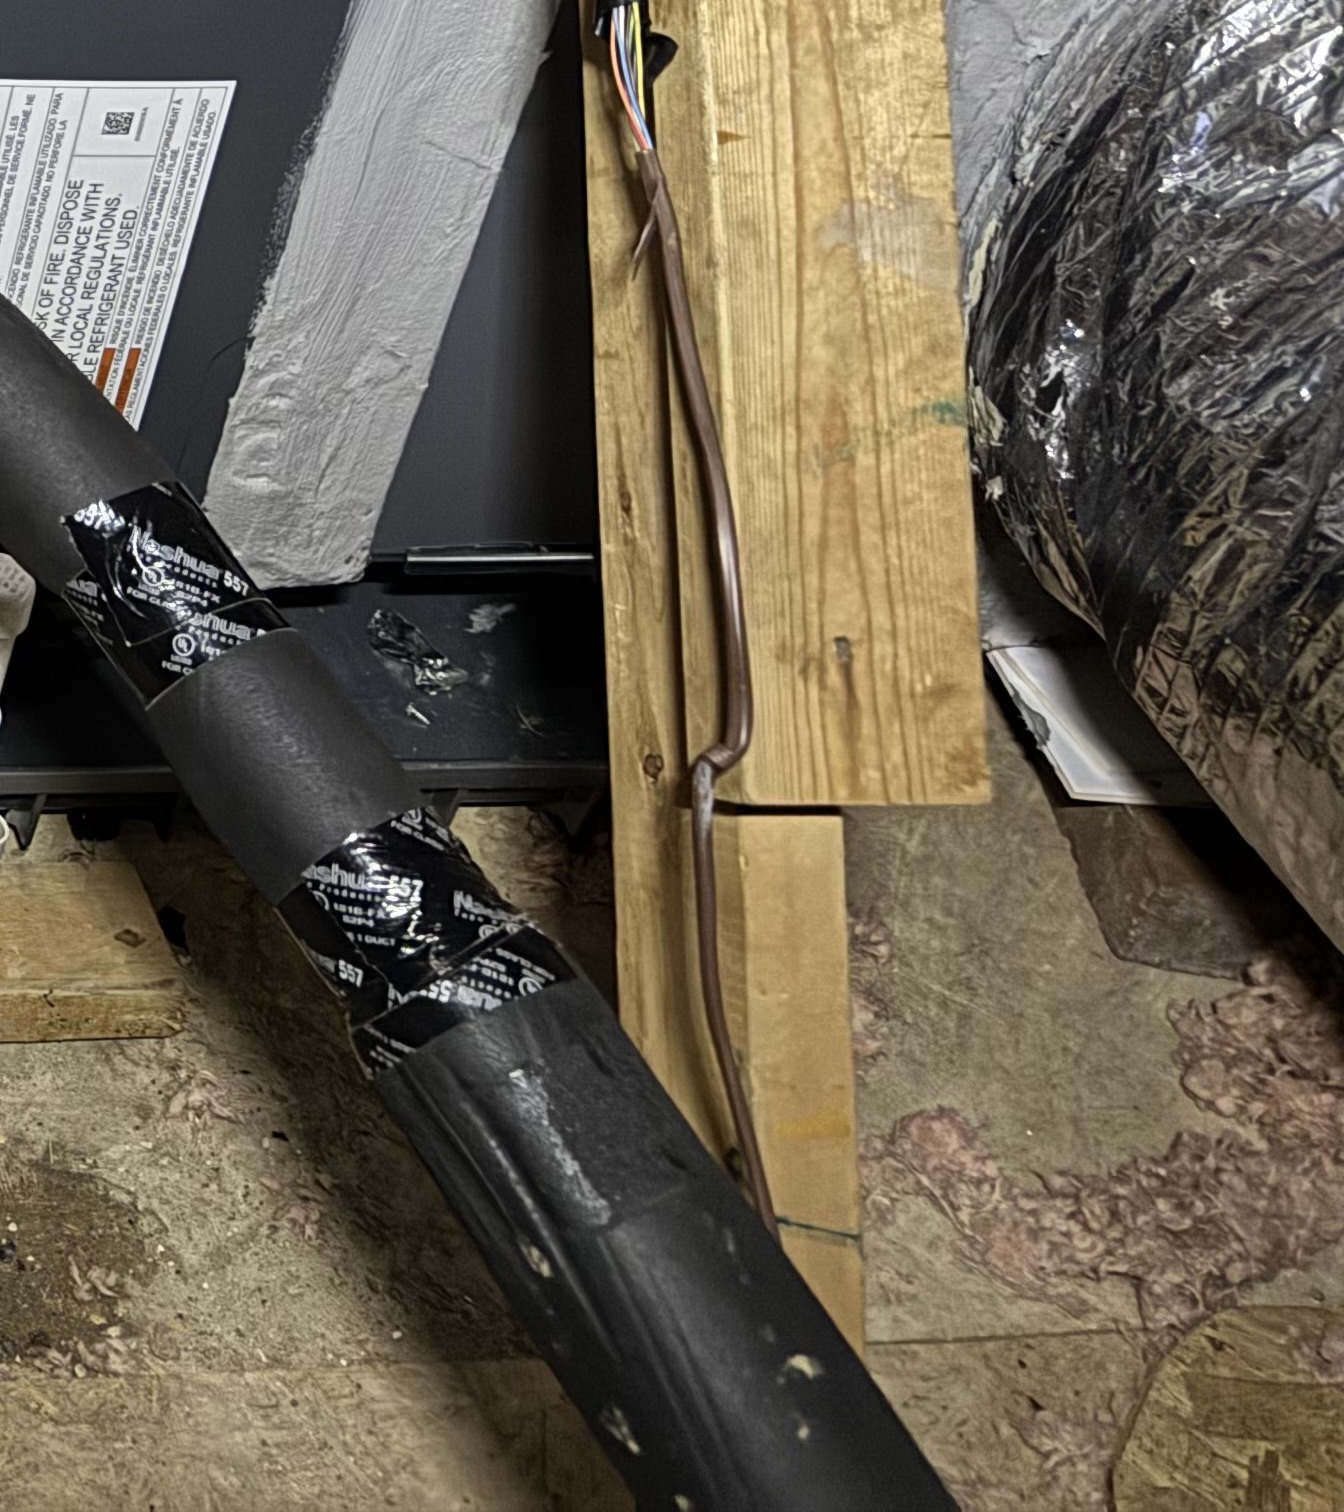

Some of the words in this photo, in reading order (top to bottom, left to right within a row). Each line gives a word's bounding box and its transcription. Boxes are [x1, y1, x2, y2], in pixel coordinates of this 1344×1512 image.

[52, 179, 84, 244] DISPOSE
[42, 249, 66, 284] FIRE.
[52, 225, 93, 325] ACCORDANCE
[79, 183, 104, 221] WITH
[79, 193, 122, 299] REGULATIONS.
[36, 289, 56, 307] OF
[86, 253, 127, 352] REFRIGERANT
[113, 206, 139, 249] USED.
[67, 304, 93, 348] LOCAL
[128, 524, 222, 581] Nashua
[222, 569, 250, 597] 557
[338, 959, 364, 989] 557
